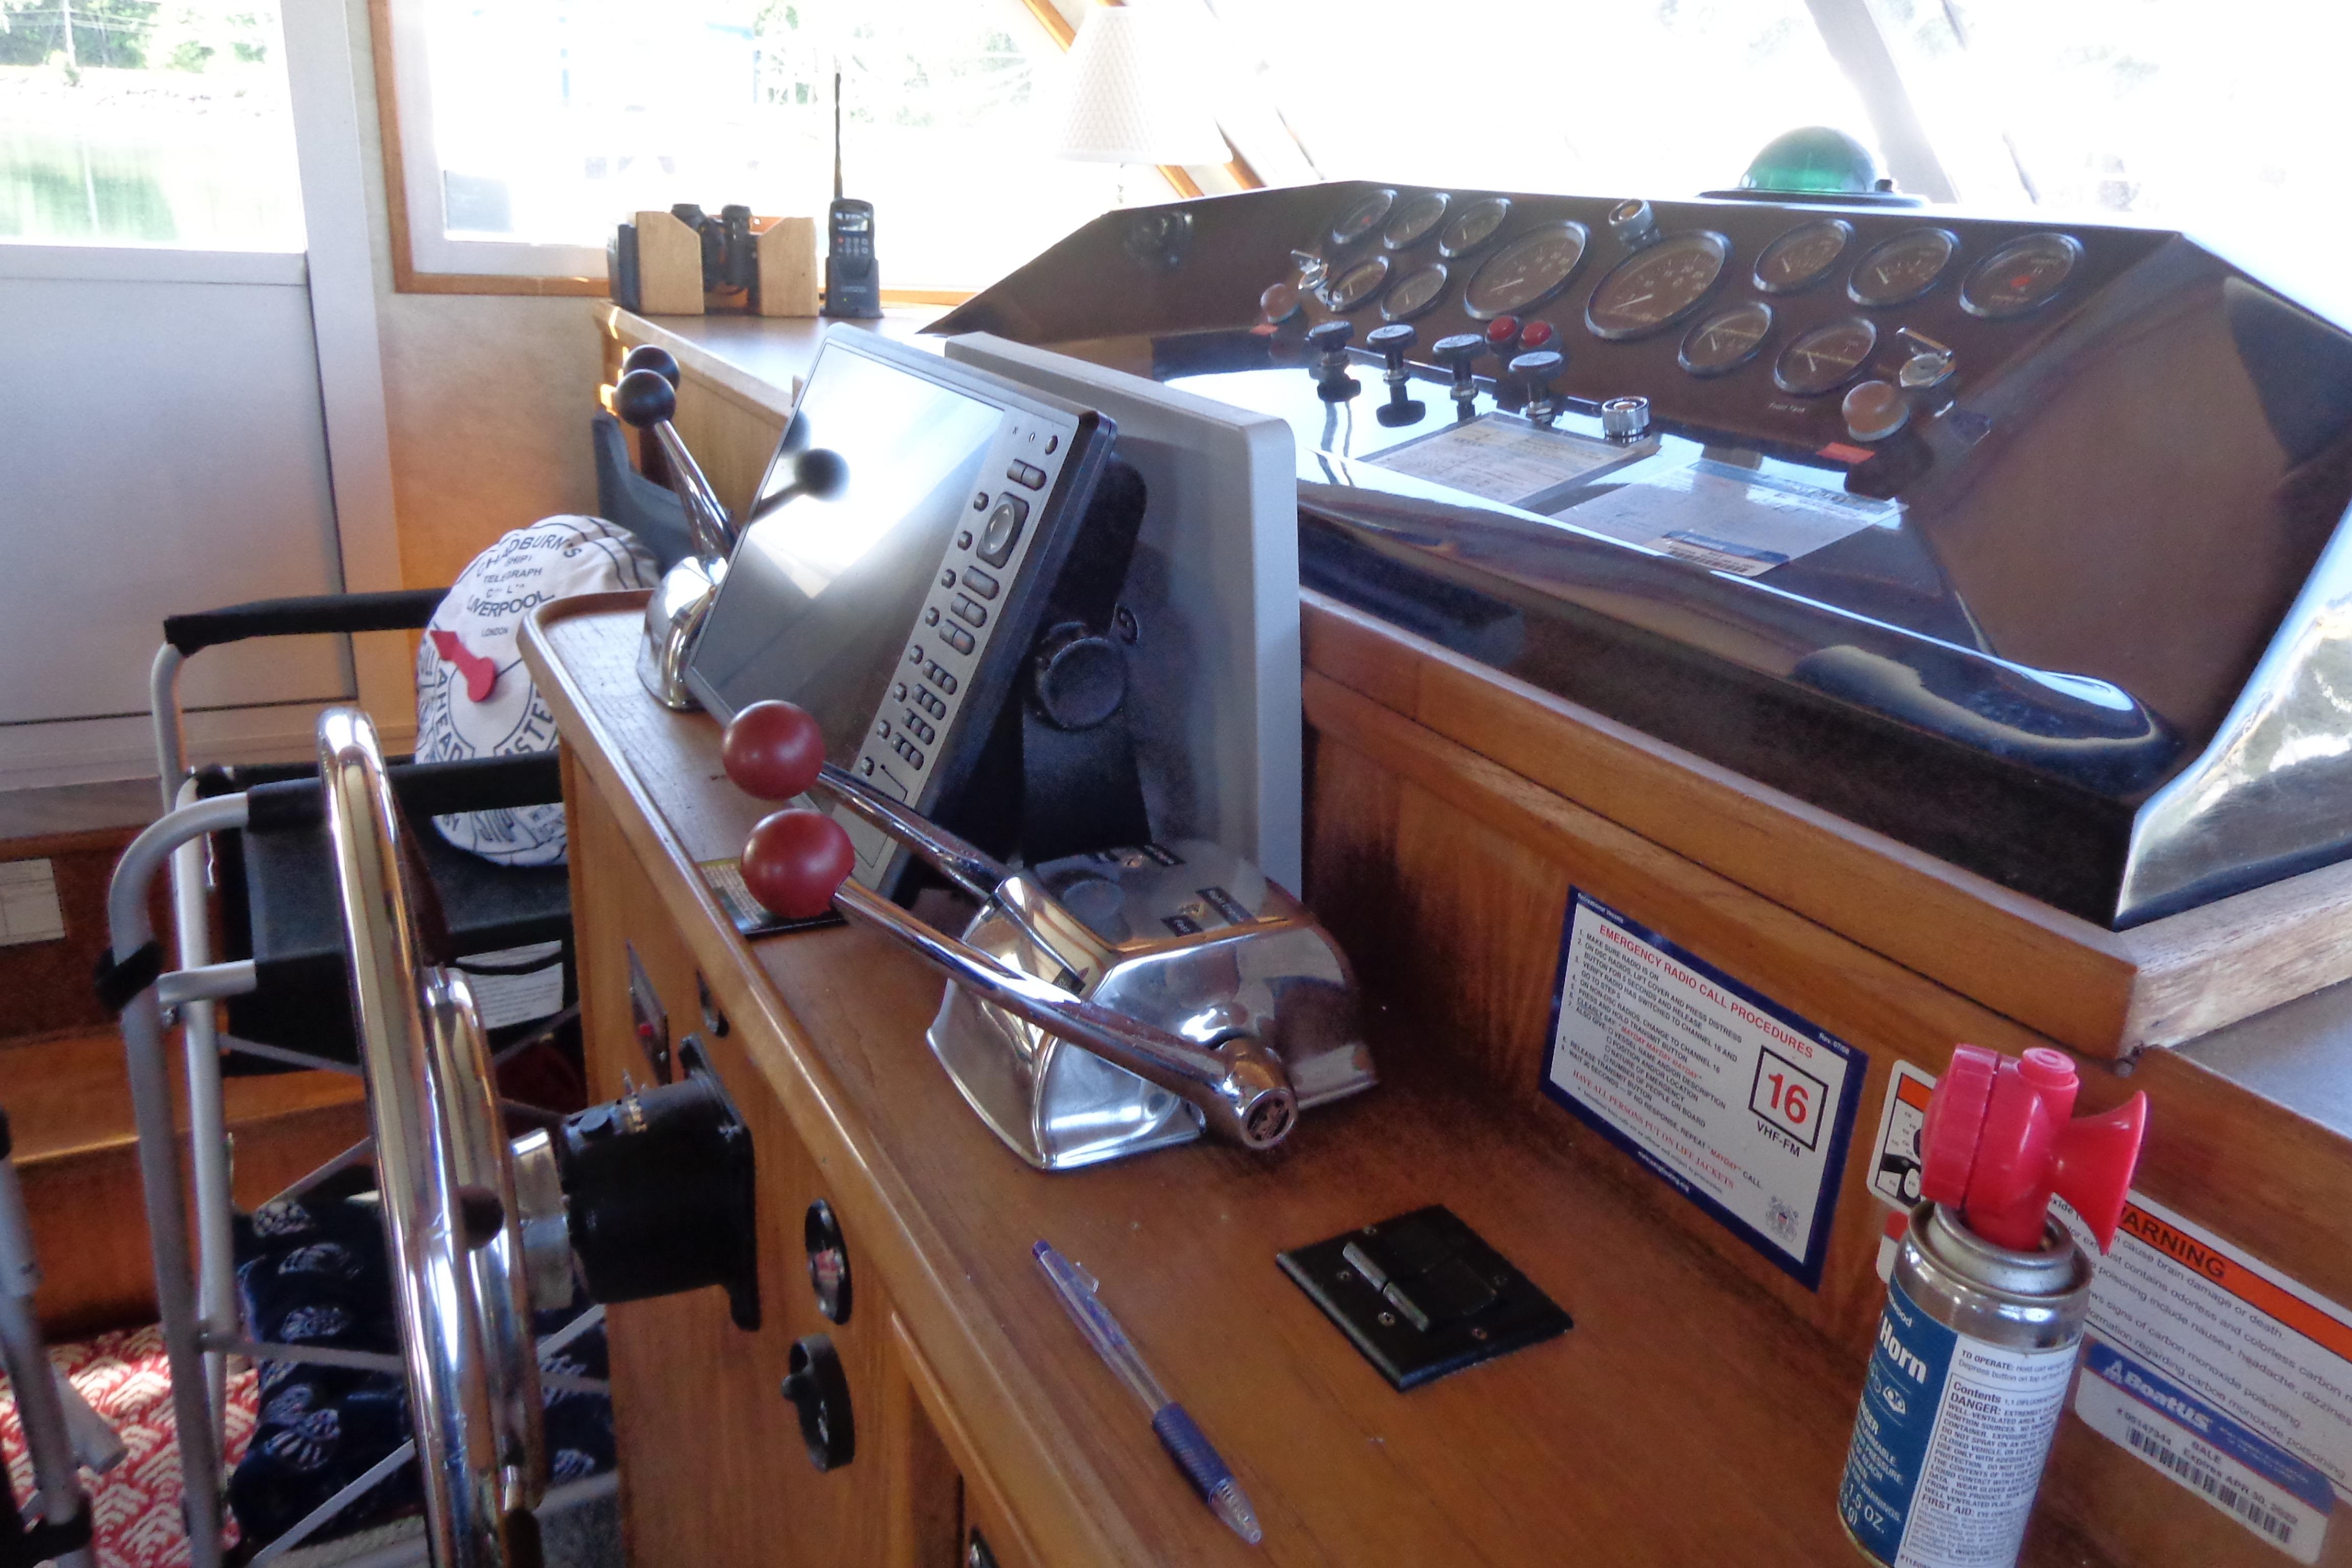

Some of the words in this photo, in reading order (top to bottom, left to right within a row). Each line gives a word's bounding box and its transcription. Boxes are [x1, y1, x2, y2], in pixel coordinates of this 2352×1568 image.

[483, 567, 543, 583] TELEGRAPH
[481, 627, 509, 637] LONDON
[1581, 969, 1591, 981] GO
[1591, 975, 1600, 987] TO
[1600, 981, 1616, 997] STEP
[1586, 932, 1603, 948] MAKE
[1604, 943, 1621, 959] SURE
[1621, 953, 1641, 971] RADIO
[1641, 966, 1648, 975] IS
[1649, 970, 1659, 982] ON
[1582, 960, 1603, 979] VERIFY
[1604, 973, 1623, 991] RADIO
[1624, 986, 1637, 1000] HAS
[1637, 994, 1671, 1021] SWITCHED
[1671, 1016, 1680, 1027] TO
[1681, 1021, 1712, 1047] CHANNEL
[1713, 1042, 1722, 1053] 16
[1722, 1047, 1738, 1063] AND
[1583, 950, 1608, 971] BUTTON
[1608, 966, 1622, 980] FOR
[1627, 977, 1657, 1002] SECONDS
[1657, 996, 1672, 1011] AND
[1672, 1005, 1702, 1030] RELEASE
[1584, 941, 1594, 953] ON
[1595, 947, 1607, 961] DSC
[1607, 955, 1633, 977] RADIOS,
[1633, 971, 1646, 985] LIFT
[1647, 979, 1670, 1000] COVER
[1670, 993, 1684, 1009] AND
[1685, 1002, 1707, 1023] PRESS
[1708, 1017, 1743, 1044] DISTRESS
[1599, 923, 1662, 969] EMERGENCY
[1663, 961, 1698, 991] RADIO
[1698, 982, 1728, 1009] CALL
[1730, 1000, 1814, 1060] PROCEDURES
[1577, 996, 1603, 1019] CLEARLY
[1646, 1041, 1671, 1063] MAYDAY
[1578, 987, 1598, 1006] PRESS
[1598, 1000, 1611, 1014] AND
[1611, 1009, 1629, 1025] HOLD
[1629, 1020, 1660, 1046] TRANSMIT
[1661, 1040, 1687, 1064] BUTTON
[1580, 978, 1589, 990] ON
[1642, 1018, 1670, 1041] CHANGE
[1670, 1036, 1680, 1048] TO
[1680, 1042, 1711, 1068] CHANNEL
[1712, 1063, 1721, 1074] 16
[1570, 1040, 1596, 1064] RELEASE
[1597, 1059, 1626, 1084] TRANSMIT
[1627, 1079, 1652, 1102] BUTTON
[1576, 1005, 1592, 1021] ALSO
[1614, 1030, 1636, 1051] VESSEL
[1637, 1046, 1655, 1064] NAME
[1656, 1058, 1681, 1081] AND/OR
[1681, 1075, 1726, 1111] DESCRIPTION
[1610, 1048, 1634, 1070] NATURE
[1635, 1064, 1646, 1077] OF
[1645, 1071, 1685, 1104] EMERGENCY
[1612, 1039, 1640, 1064] POSITION
[1640, 1058, 1665, 1080] AND/OR
[1665, 1074, 1699, 1102] LOCATION
[1569, 1048, 1582, 1064] WAIT
[1590, 1064, 1619, 1090] SECONDS
[1626, 1089, 1632, 1098] IF
[1633, 1094, 1643, 1107] NO
[1680, 1126, 1705, 1150] REPEAT
[1609, 1057, 1635, 1080] NUMBER
[1635, 1075, 1644, 1086] OF
[1645, 1082, 1670, 1104] PEOPLE
[1671, 1099, 1681, 1112] ON
[1682, 1107, 1706, 1129] BOARD
[1762, 1066, 1811, 1129] 16
[1573, 1069, 1592, 1089] HAVE
[1593, 1083, 1606, 1099] ALL
[1609, 1094, 1644, 1125] PERSONS
[1645, 1119, 1660, 1137] PUT
[1661, 1132, 1674, 1147] ON
[1675, 1141, 1694, 1162] LIFE
[1696, 1156, 1735, 1190] JACKETS
[1755, 1119, 1801, 1158] VHF-FM
[2119, 1205, 2226, 1282] ARNING
[2098, 1265, 2148, 1303] poisoning
[2149, 1295, 2189, 1327] include
[2121, 1238, 2154, 1264] cause
[2156, 1258, 2185, 1282] brain
[2186, 1275, 2232, 1312] damage
[2234, 1305, 2247, 1320] or
[1880, 1315, 1927, 1384] Horn
[2105, 1300, 2133, 1324] signs
[2134, 1316, 2147, 1331] of
[2147, 1325, 2186, 1356] carbon
[2187, 1349, 2242, 1392] monoxide
[2123, 1259, 2168, 1293] contains
[2170, 1287, 2217, 1322] odorless
[2219, 1316, 2241, 1337] and
[2244, 1330, 2295, 1370] colorless
[2298, 1362, 2341, 1398] carbon
[1957, 1358, 1990, 1377] Depress
[1991, 1370, 2017, 1382] button
[1961, 1349, 1973, 1359] TO
[1973, 1354, 2014, 1371] OPERATE:
[1949, 1391, 2002, 1416] DANGER:
[1952, 1381, 2002, 1404] Contents
[2134, 1336, 2186, 1378] regarding
[2187, 1370, 2226, 1403] carbon
[2228, 1397, 2284, 1441] monoxide
[1938, 1433, 1970, 1450] CLOSED
[1941, 1426, 1953, 1436] DO
[1953, 1430, 1969, 1441] NOT
[1970, 1436, 1996, 1447] SPRAY
[1945, 1409, 1980, 1428] IGNITION
[1930, 1463, 1956, 1479] LIQUID
[1956, 1474, 1992, 1486] CONTACT
[1937, 1441, 1951, 1452] USE
[1953, 1447, 1973, 1459] ONLY
[1974, 1454, 1994, 1462] WITH
[1948, 1462, 1989, 1478] CONTENTS
[2183, 1447, 2223, 1478] Expires
[2225, 1474, 2249, 1495] APR
[1921, 1493, 1952, 1512] FIRST
[1953, 1505, 1975, 1517] AID:
[1924, 1485, 1944, 1498] WELL
[1925, 1478, 1949, 1492] FROM
[1950, 1487, 1968, 1498] THIS
[1955, 1481, 1978, 1491] WEAR
[1864, 1505, 1885, 1535] OZ.
